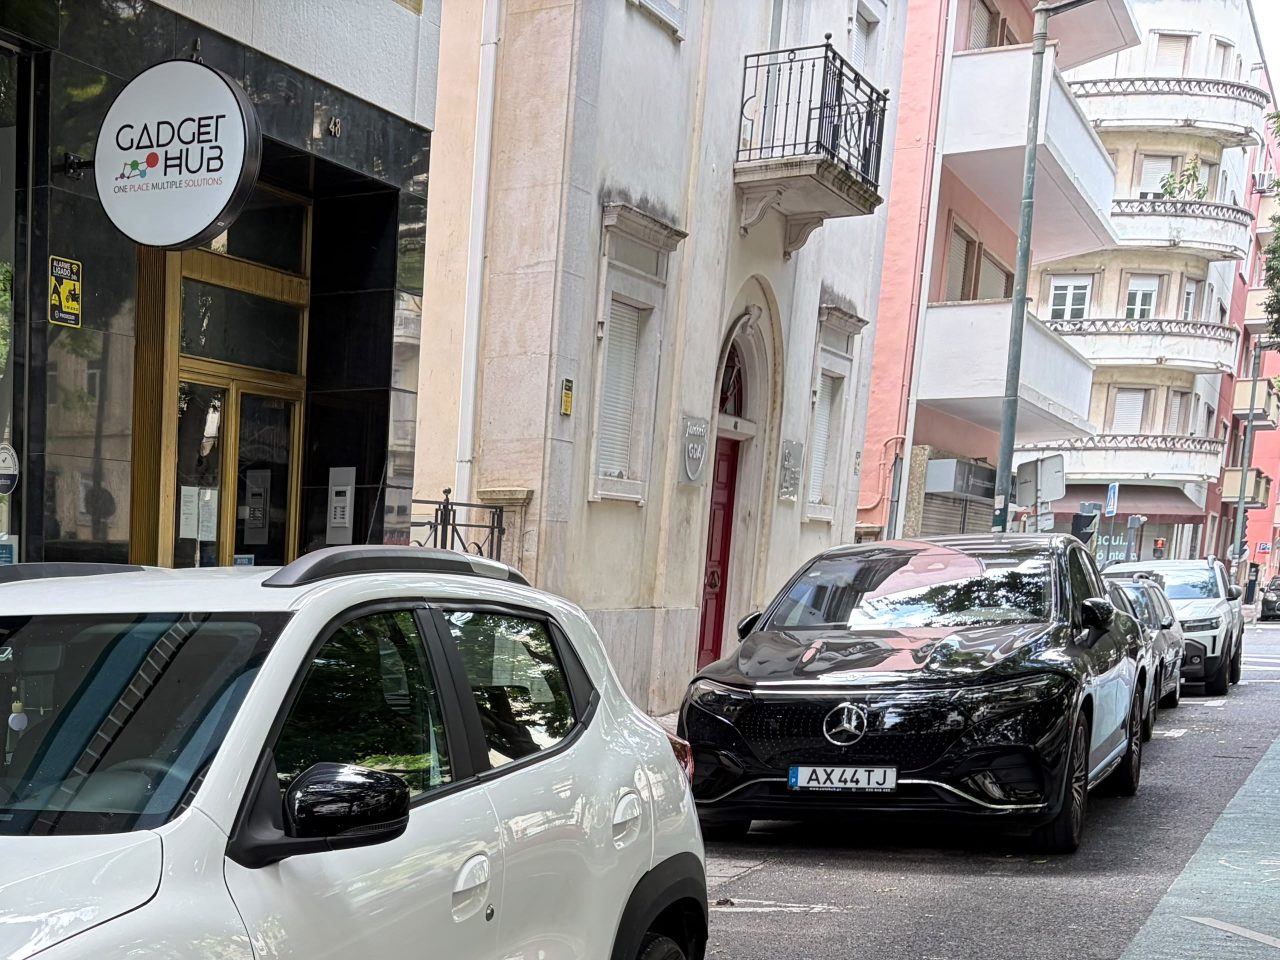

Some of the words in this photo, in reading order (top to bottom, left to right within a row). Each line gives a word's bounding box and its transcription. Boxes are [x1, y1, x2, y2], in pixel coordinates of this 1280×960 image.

[116, 114, 226, 151] GADGET
[328, 116, 341, 138] 48
[164, 145, 224, 176] HUB
[113, 185, 128, 194] ONE
[129, 183, 150, 192] PLACE
[151, 180, 183, 191] MULTIPLE
[184, 177, 223, 188] SOLUTIONS
[806, 768, 887, 786] AX44TJ
